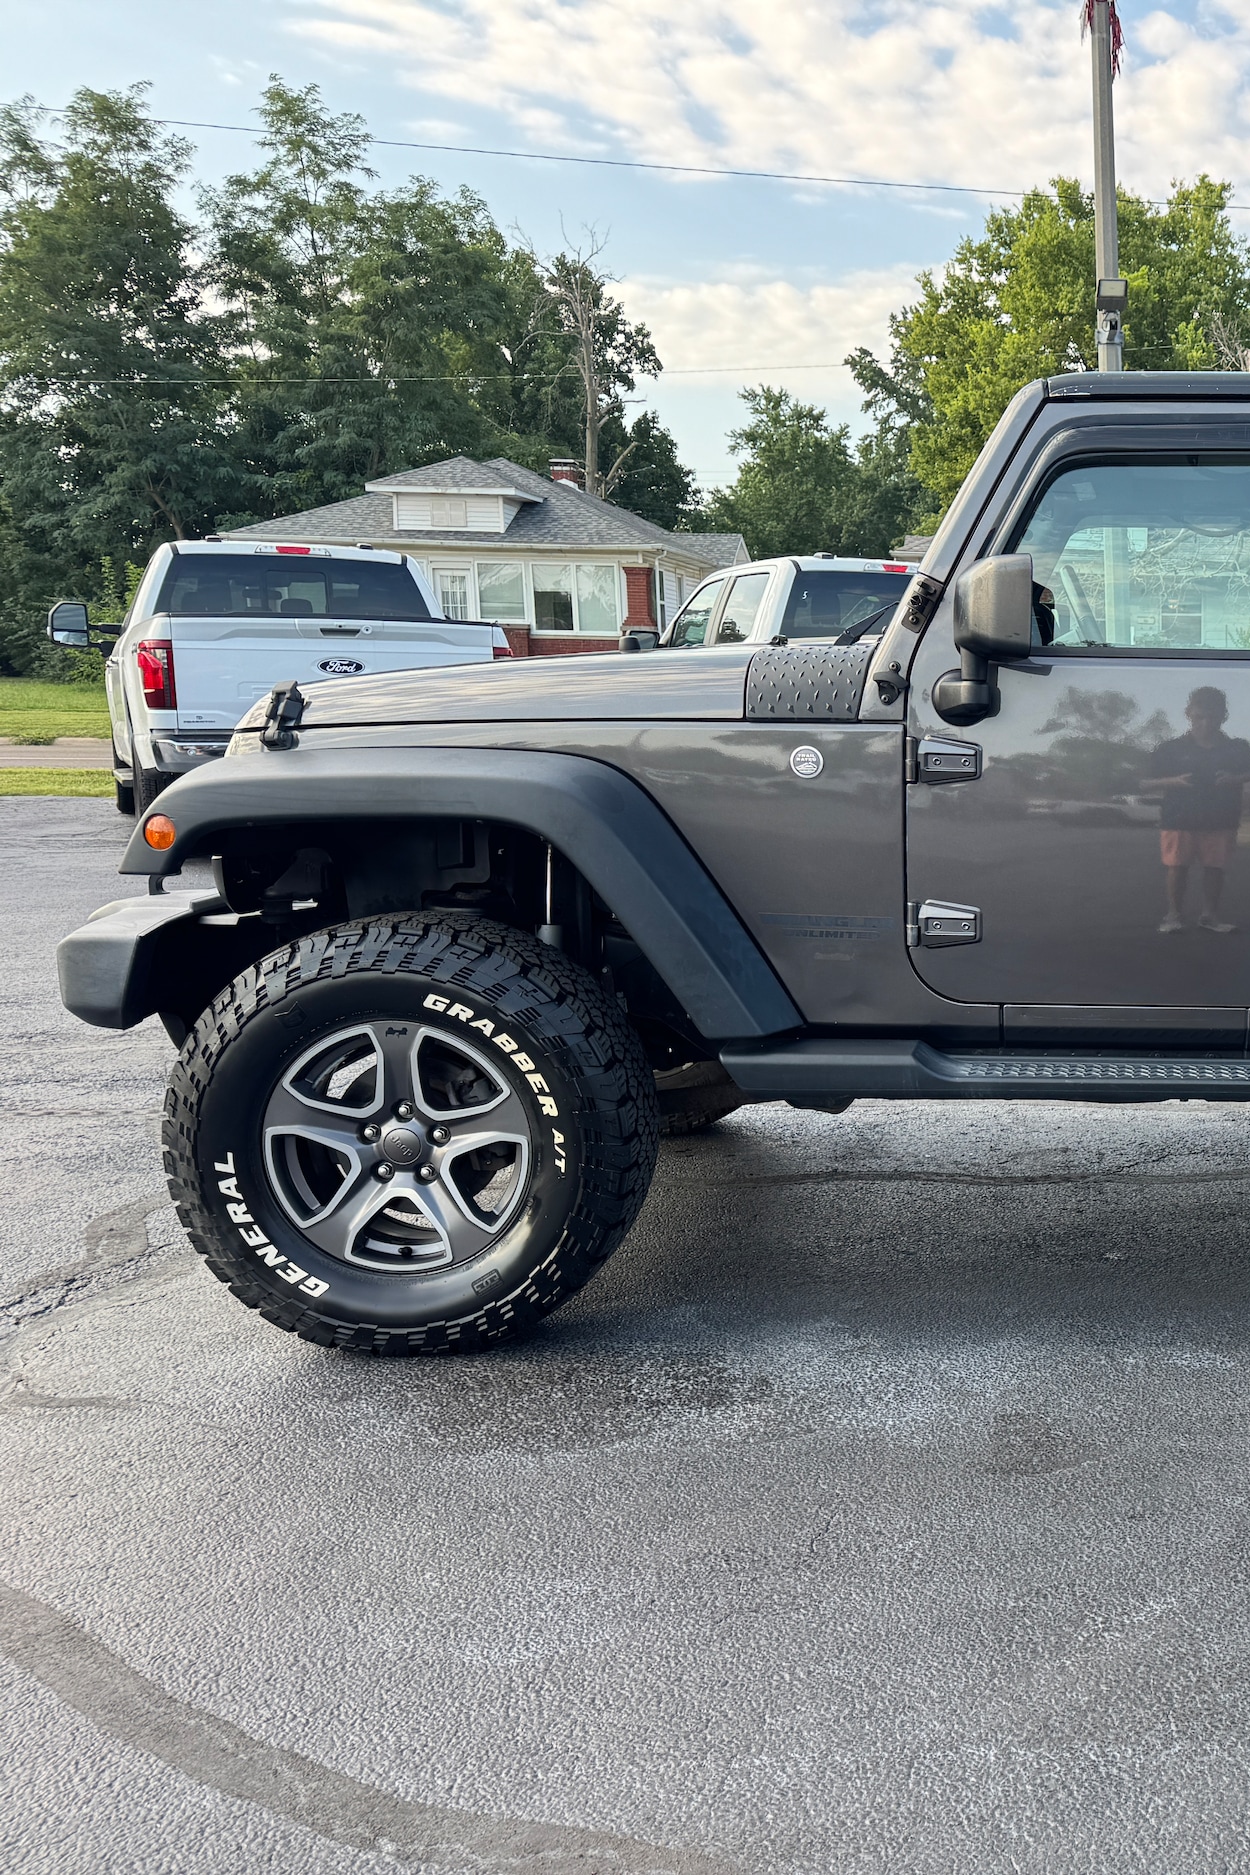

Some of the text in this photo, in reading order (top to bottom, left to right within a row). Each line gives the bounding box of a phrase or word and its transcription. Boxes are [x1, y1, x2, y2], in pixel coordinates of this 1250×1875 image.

[326, 660, 357, 673] Ford
[422, 993, 559, 1117] GRABBER
[552, 1128, 566, 1174] A/T
[390, 1135, 414, 1156] Jeep
[214, 1152, 330, 1298] GENERAL
